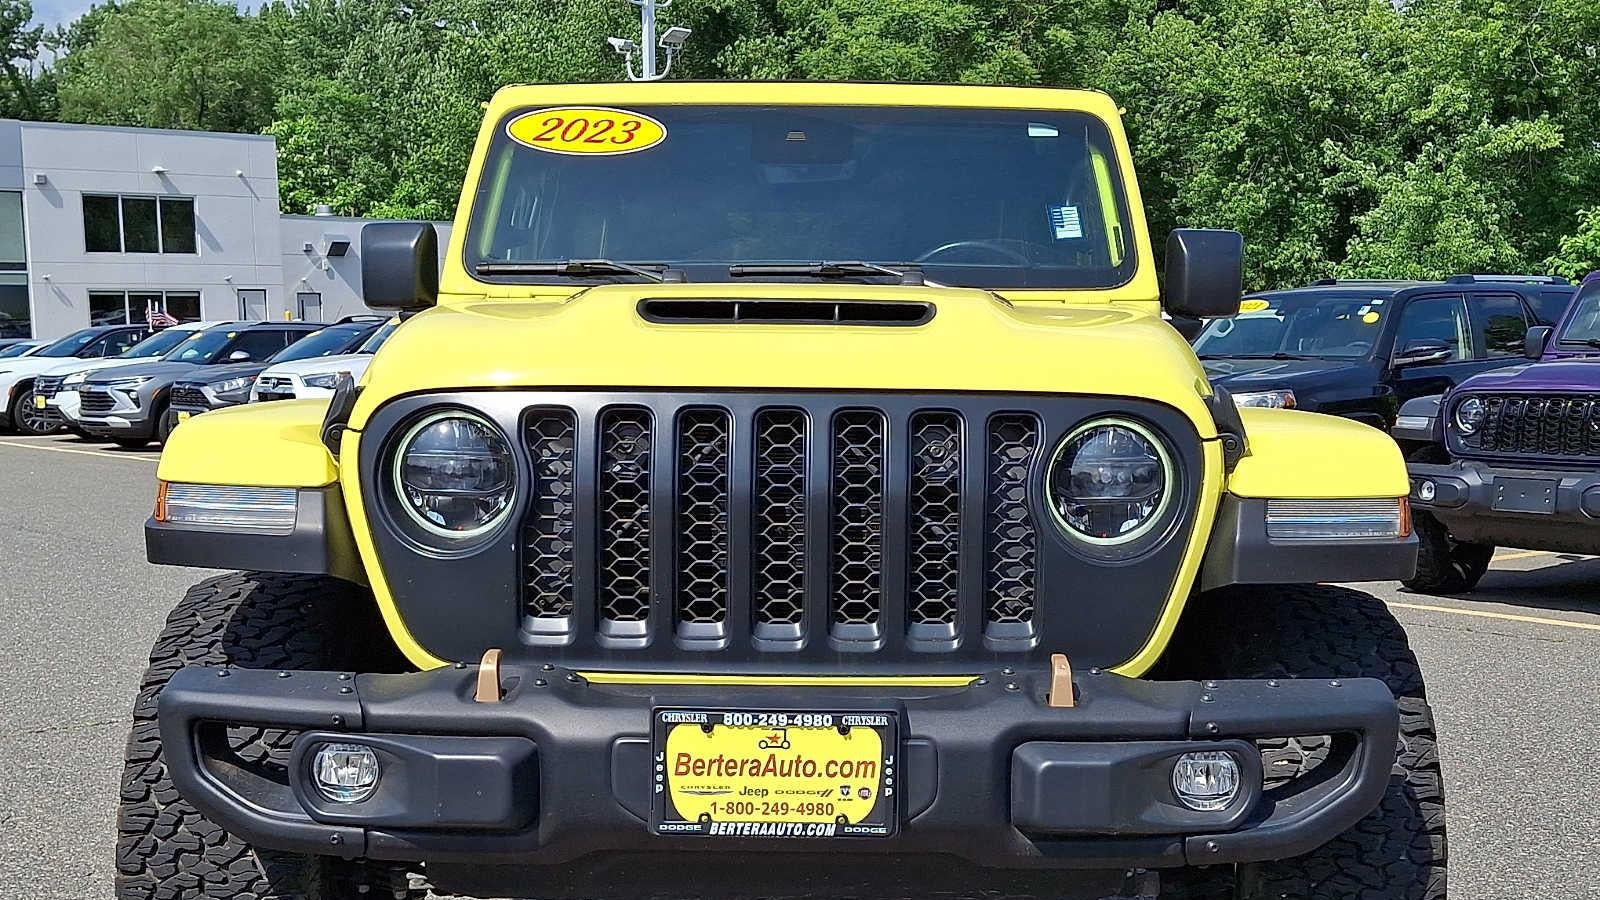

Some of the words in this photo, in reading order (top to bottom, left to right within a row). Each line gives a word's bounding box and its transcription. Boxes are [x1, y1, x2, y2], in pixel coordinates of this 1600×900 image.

[532, 117, 642, 144] 2023
[661, 712, 708, 723] CHRYSLER
[723, 713, 833, 727] 800-249-4980
[841, 715, 889, 726] CHRYSLER
[655, 752, 664, 794] Jeep
[674, 752, 877, 779] BerteraAuto.com
[884, 755, 894, 797] Jeep
[739, 785, 769, 798] Jeep
[710, 801, 835, 816] 1-800-249-4980
[709, 822, 837, 837] BERTERAAUTO.COM
[844, 826, 889, 834] DODGE
